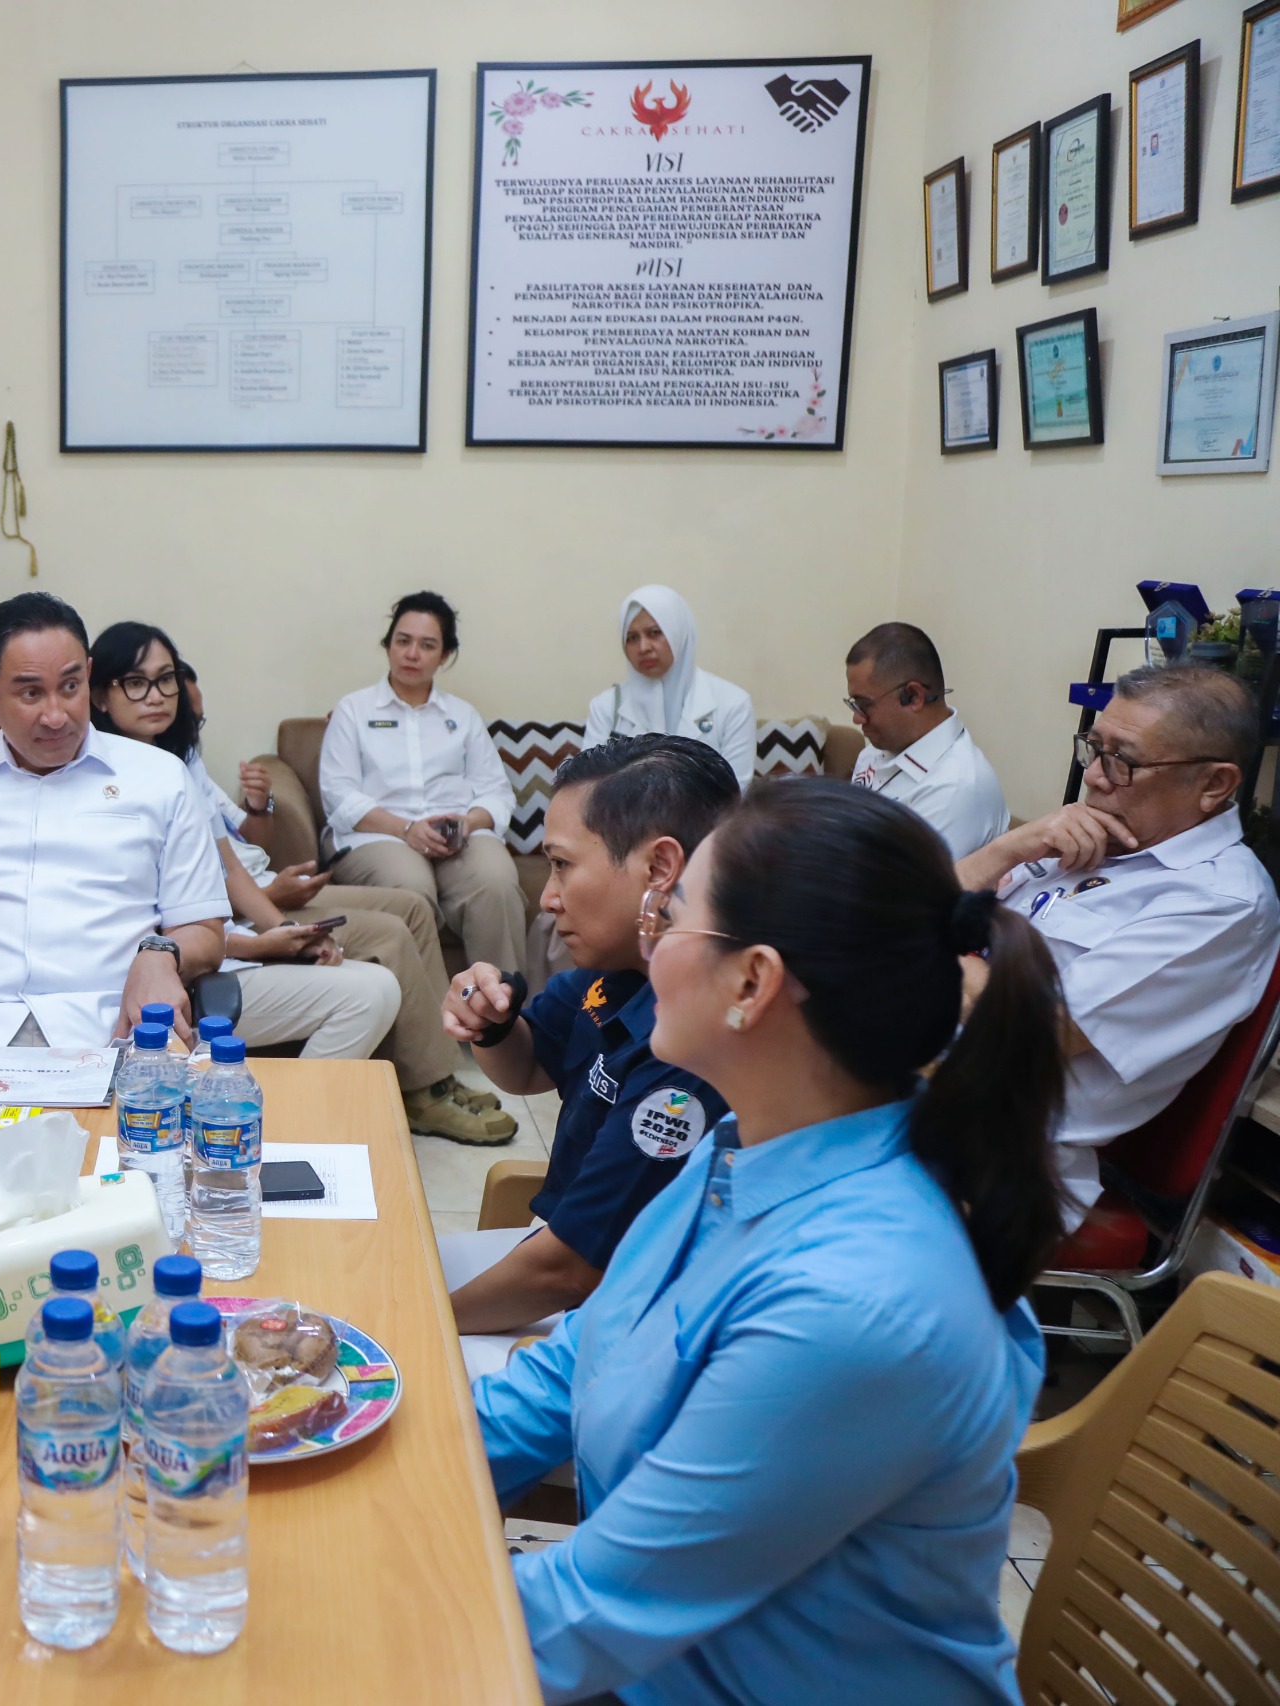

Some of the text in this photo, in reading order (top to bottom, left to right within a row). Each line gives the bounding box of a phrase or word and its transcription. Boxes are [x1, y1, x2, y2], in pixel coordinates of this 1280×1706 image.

[581, 124, 745, 137] CAKRA SEHATI
[646, 152, 684, 172] VISI
[494, 176, 836, 188] TERWUJUDNYA PERLUASAN AKSES LAYANAN REHABILITASI
[504, 186, 826, 196] TERHADAP KORBAN DAN PENYALAHGUNAAN NARKOTIKA
[522, 194, 805, 205] DAN PSIKOTROPIKA DALAM RANGKA MENDUKUNG
[542, 204, 784, 214] PROGRAM PENCEGAHAN PEMBERANTASAN
[504, 212, 822, 223] PENYALAHGUNAAN DAN PEREDARAN GELAP NARKOTIKA
[513, 222, 812, 232] (P4GN) SEHINGGA DAPAT MEWUJUDKAN PERBAIKAN
[518, 231, 806, 241] KUALITAS GENERASI MUDA INDONESIA SEHAT DAN
[526, 283, 813, 292] FASILITATOR AKSES LAYANAN KESEHATAN DAN
[514, 292, 824, 301] PENDAMPINGAN BAGI KORBAN DAN PENYALAHGUNA
[572, 301, 642, 310] NARKOTIKA
[644, 301, 670, 310] DAN
[512, 315, 567, 324] MENJADI
[570, 315, 602, 324] AGEN
[605, 315, 658, 324] EDUKASI
[660, 315, 702, 324] DALAM
[705, 315, 764, 324] PROGRAM
[524, 328, 810, 337] KELOMPOK PEMBERDAYA MANTAN KORBAN DAN
[584, 338, 672, 346] PENYALAGUNA
[516, 350, 816, 359] SEBAGAI MOTIVATOR DAN FASILITATOR JARINGAN
[508, 359, 546, 368] KERJA
[549, 359, 590, 368] ANTAR
[672, 359, 737, 368] KELOMPOK
[740, 359, 766, 368] DAN
[768, 360, 823, 368] INDIVIDU
[594, 368, 636, 376] DALAM
[638, 368, 659, 376] ISU
[520, 380, 790, 389] BERKONTRIBUSI DALAM PENGKAJIAN ISU-ISU
[508, 389, 800, 398] TERKAIT MASALAH PENYALAGUNAAN NARKOTIKA
[528, 398, 552, 406] DAN
[556, 398, 642, 406] PSIKOTROPIKA
[646, 398, 692, 406] SECARA
[694, 398, 706, 407] DI
[647, 1110, 691, 1131] IPWL
[640, 1119, 688, 1142] 2020
[43, 1438, 108, 1467] AQUA
[144, 1437, 190, 1473] AQUA
